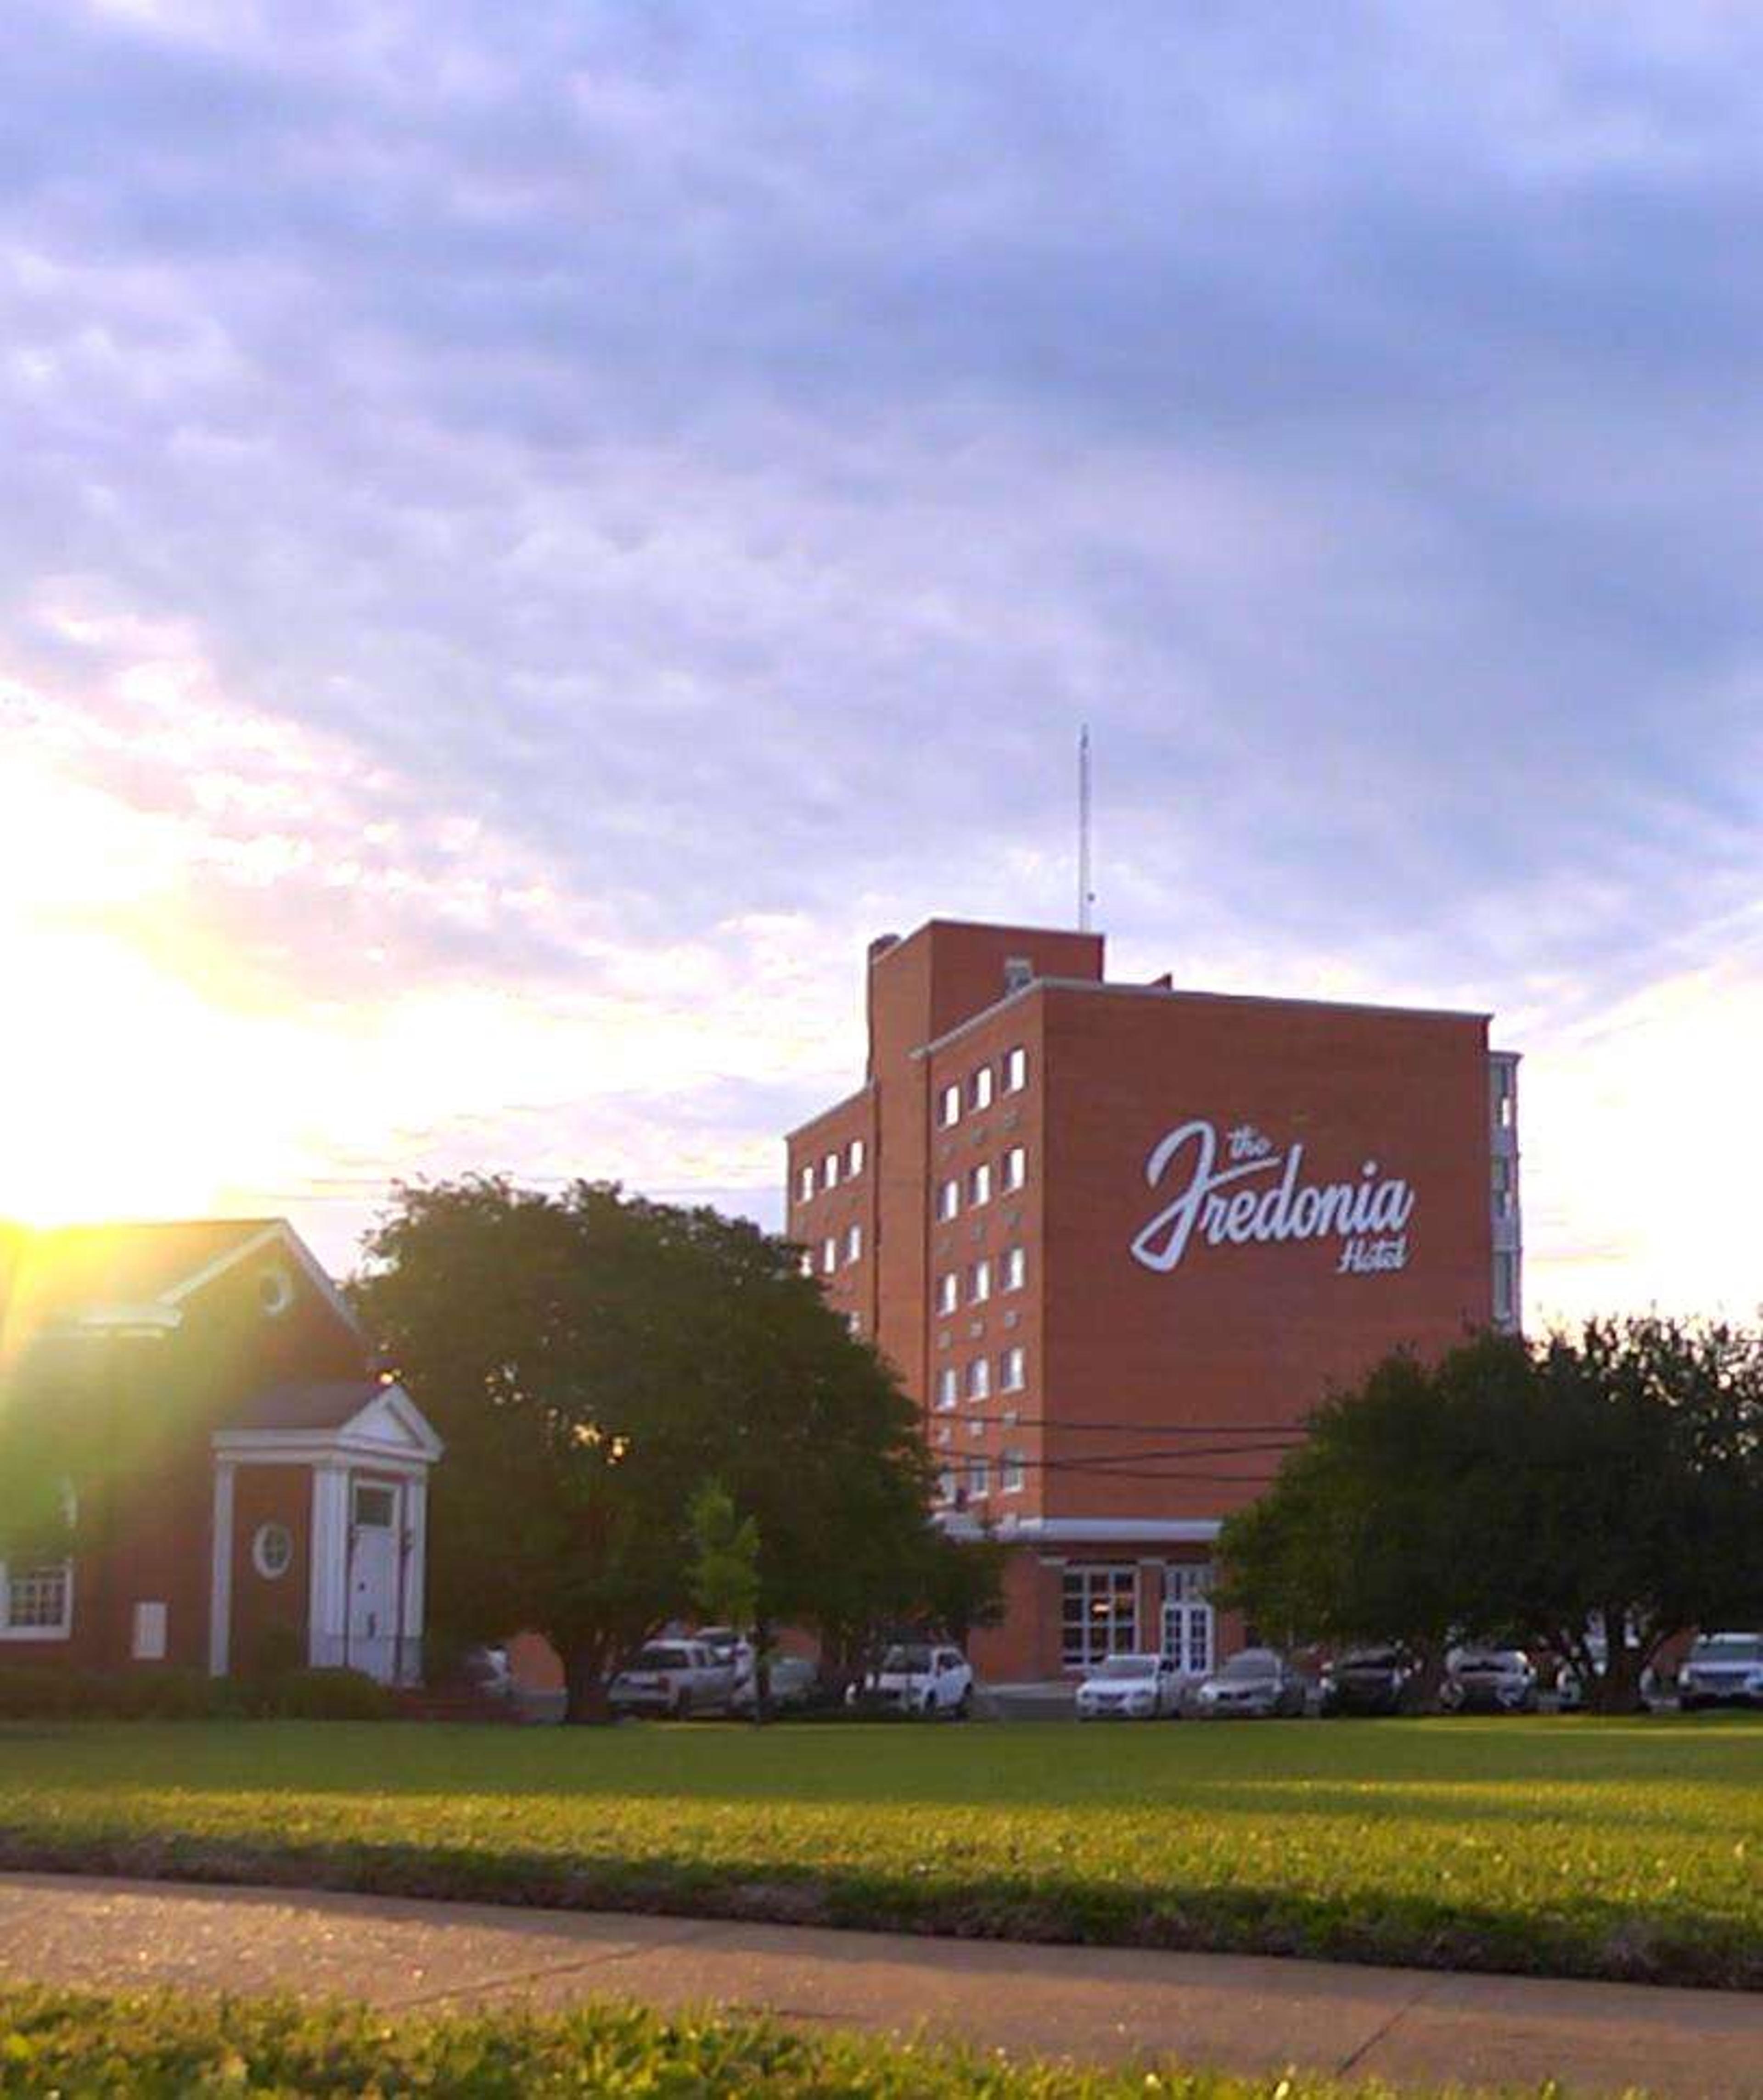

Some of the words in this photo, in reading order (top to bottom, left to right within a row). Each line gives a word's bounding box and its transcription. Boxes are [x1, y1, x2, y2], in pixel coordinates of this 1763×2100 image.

[1227, 1126, 1272, 1157] the
[1131, 1120, 1415, 1271] Fredonia
[1337, 1236, 1407, 1272] Hotel
